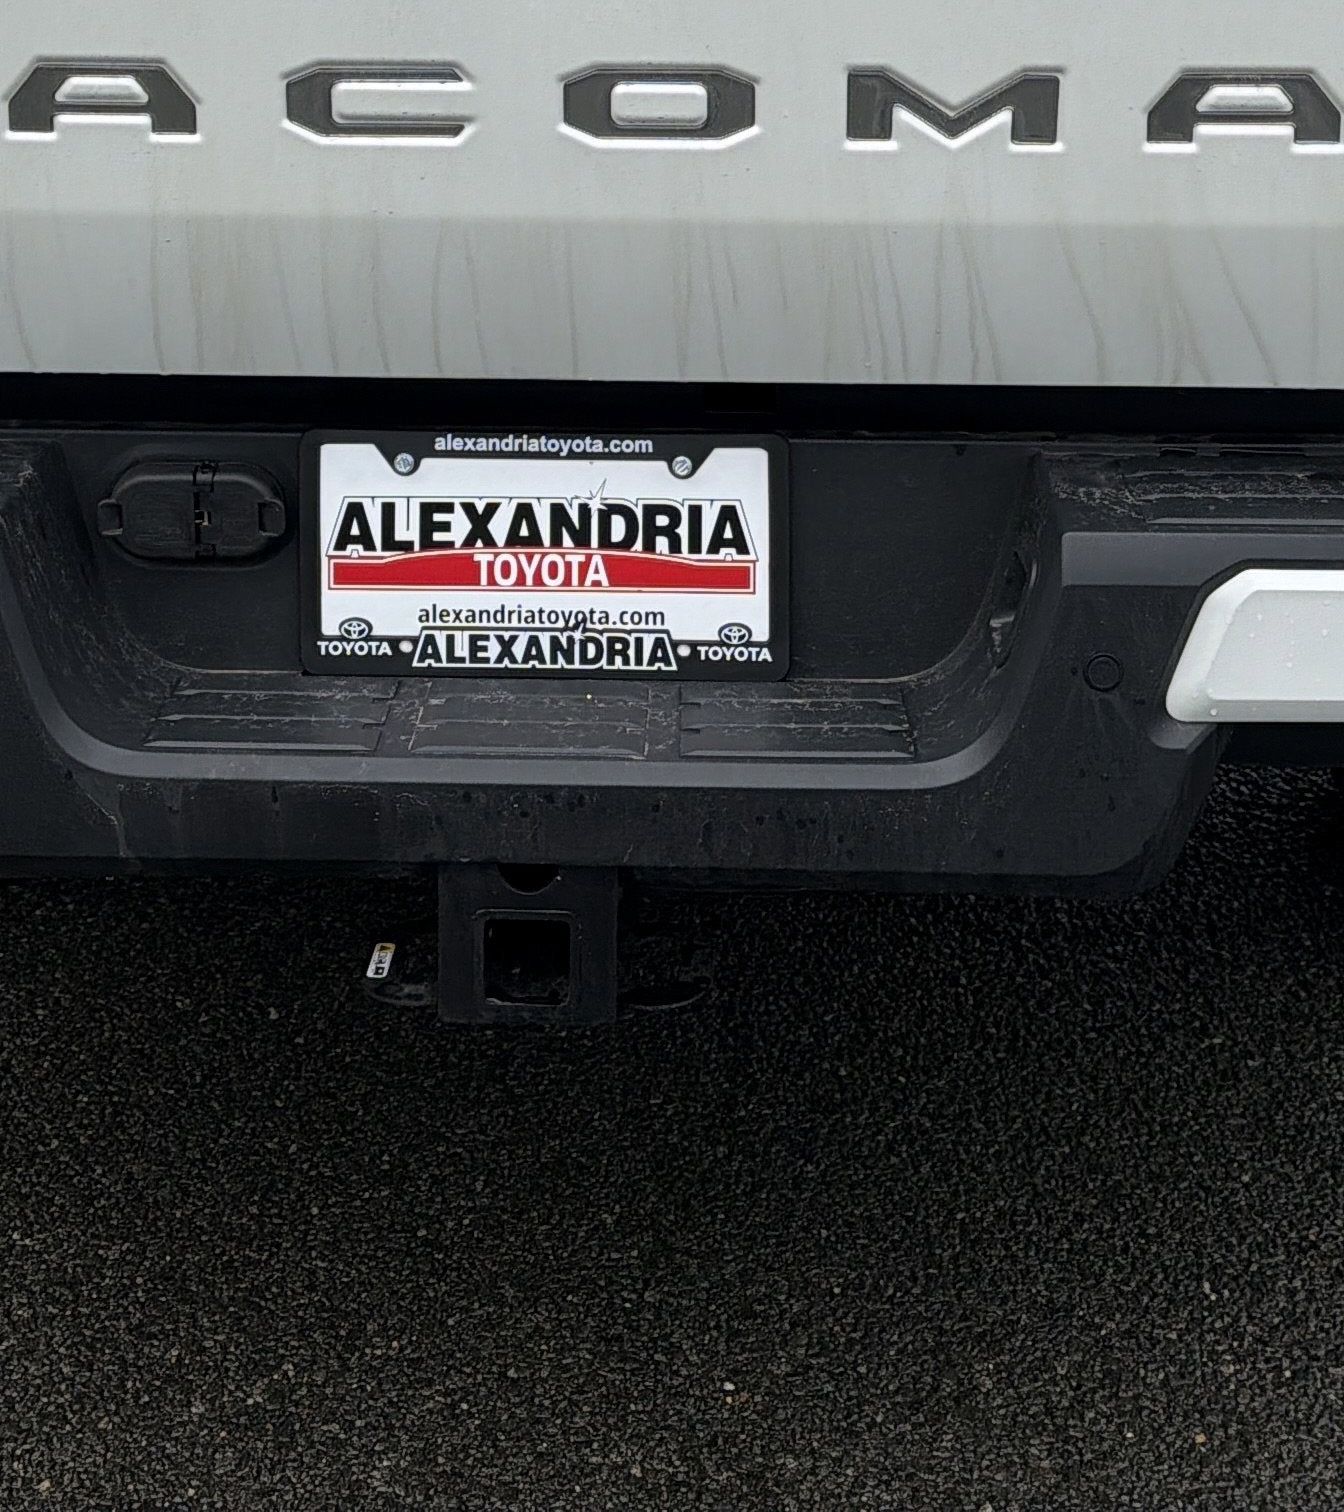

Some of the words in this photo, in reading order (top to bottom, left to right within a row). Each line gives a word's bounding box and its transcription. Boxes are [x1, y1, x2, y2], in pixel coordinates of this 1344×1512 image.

[434, 434, 654, 456] alexandriatoyota.com
[330, 499, 755, 558] ALEXANDRIA
[473, 553, 610, 587] TOYOTA
[417, 604, 666, 628] alexandriatoyota.com
[317, 640, 393, 657] TOYOTA
[414, 631, 676, 668] ALEXANDRIA
[697, 645, 773, 663] TOYOTA
